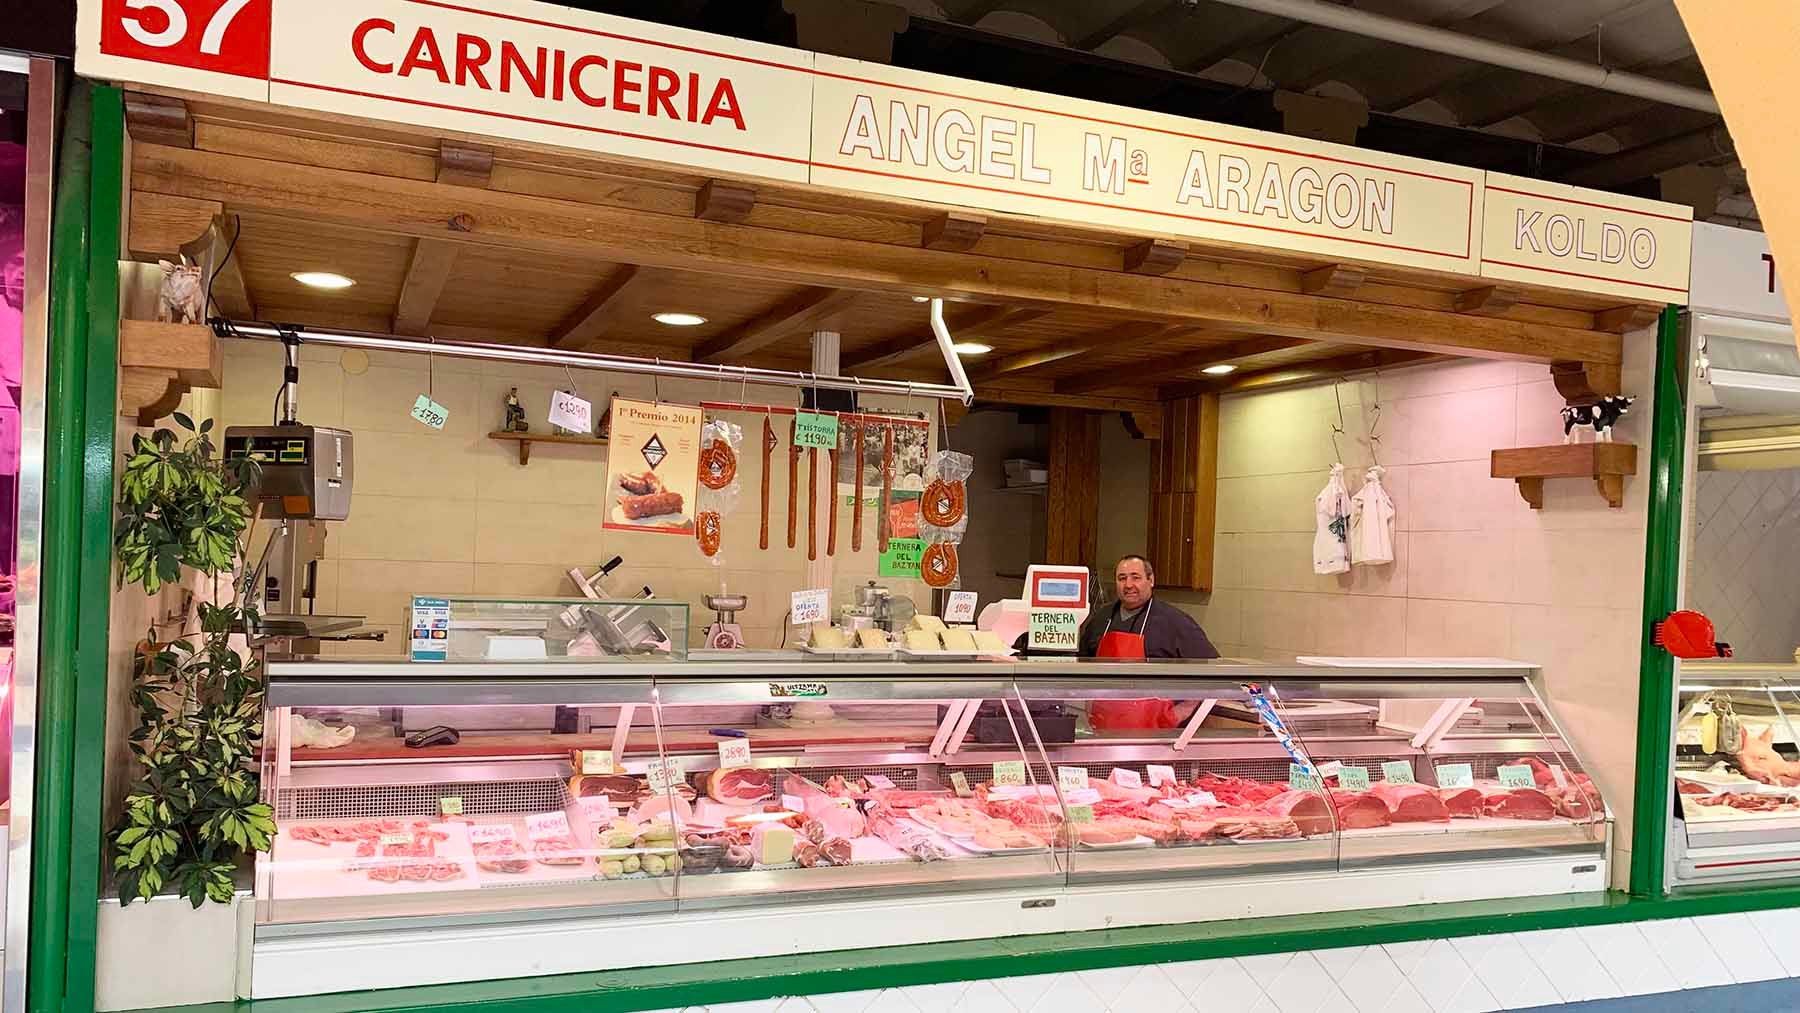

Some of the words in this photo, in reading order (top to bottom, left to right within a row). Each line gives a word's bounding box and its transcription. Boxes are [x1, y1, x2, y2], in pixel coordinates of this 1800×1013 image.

[351, 17, 747, 131] CARNICERIA
[838, 94, 1052, 185] ANGEL
[1175, 149, 1396, 235] ARAGON
[1514, 207, 1657, 270] KOLDO
[629, 407, 669, 422] Premio
[672, 412, 697, 425] 2014
[887, 541, 922, 552] TERNERA
[896, 552, 912, 561] DEL
[891, 561, 921, 570] BAZTAN
[1031, 612, 1076, 624] TERNERA
[1044, 624, 1059, 633] DEL
[1034, 631, 1076, 645] BAZTAN
